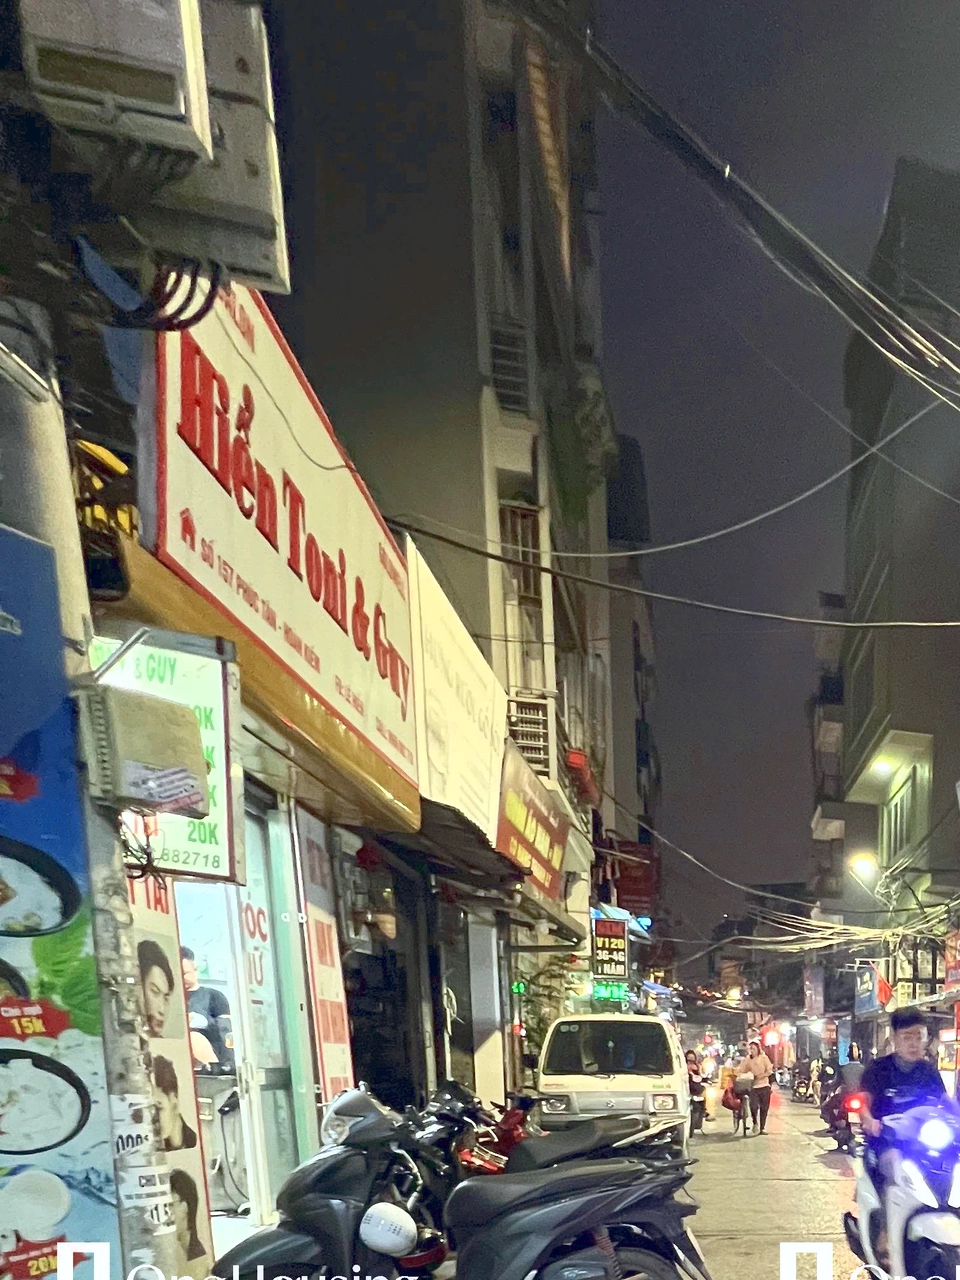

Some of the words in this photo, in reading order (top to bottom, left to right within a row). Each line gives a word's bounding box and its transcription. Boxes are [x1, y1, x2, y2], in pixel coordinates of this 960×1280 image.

[283, 468, 349, 637] Toni
[352, 575, 371, 661] &
[374, 603, 410, 722] Guy
[146, 653, 177, 685] GUY
[187, 820, 219, 845] 20K
[596, 937, 625, 949] V120
